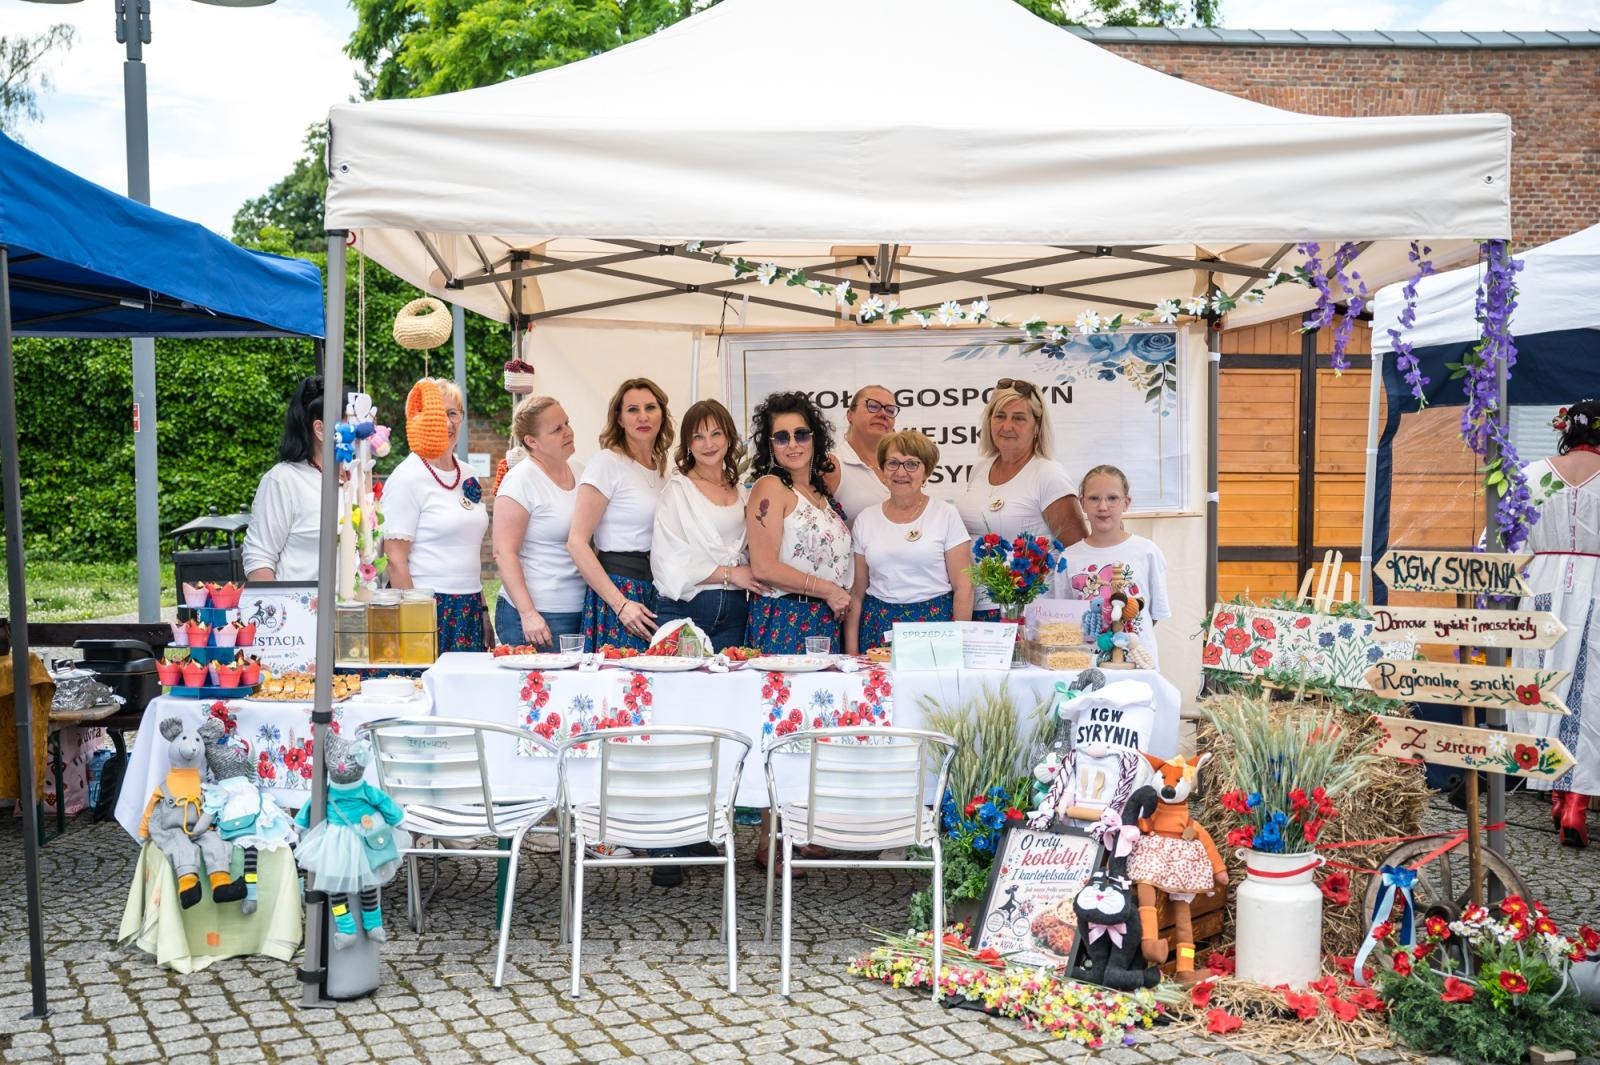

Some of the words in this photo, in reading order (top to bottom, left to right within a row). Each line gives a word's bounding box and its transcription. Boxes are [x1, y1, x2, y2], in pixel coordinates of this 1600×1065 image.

[1386, 552, 1440, 585] KGW
[1441, 557, 1522, 590] SYRYNIA
[1373, 610, 1427, 632] Domowe
[1471, 616, 1479, 632] i
[1376, 661, 1460, 696] Regionalne
[1469, 674, 1516, 692] smaki
[1090, 707, 1124, 723] KGW
[1076, 723, 1139, 749] SYRYNIA
[1400, 726, 1427, 750] Z
[1433, 739, 1487, 755] sercem
[1020, 834, 1034, 850] O
[1035, 836, 1064, 852] rety,
[1021, 843, 1089, 870] kotlety!
